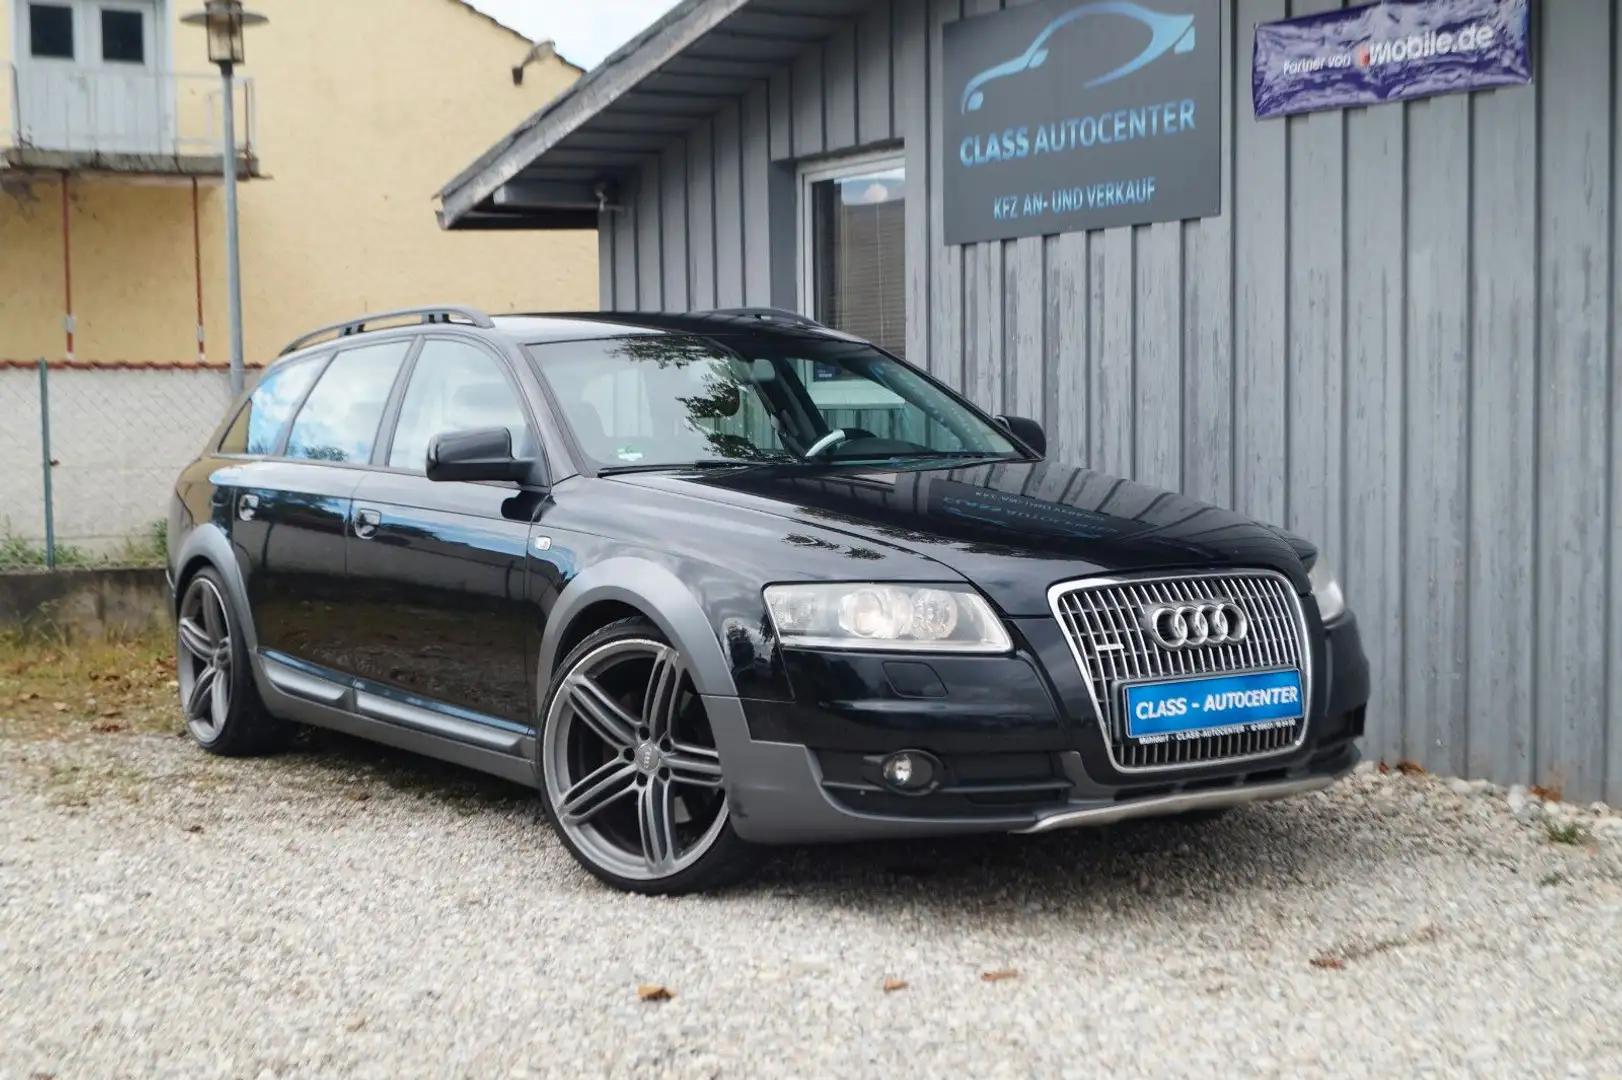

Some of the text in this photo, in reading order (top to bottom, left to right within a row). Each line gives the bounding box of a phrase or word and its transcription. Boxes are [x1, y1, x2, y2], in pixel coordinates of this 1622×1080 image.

[1283, 55, 1325, 75] Partner
[1327, 54, 1351, 68] von
[959, 97, 1196, 167] CLASS AUTOCENTER
[993, 176, 1156, 220] KFZ AN- UND VERKAUF
[1135, 697, 1187, 720] CLASS
[1203, 685, 1298, 713] AUTOCENTER
